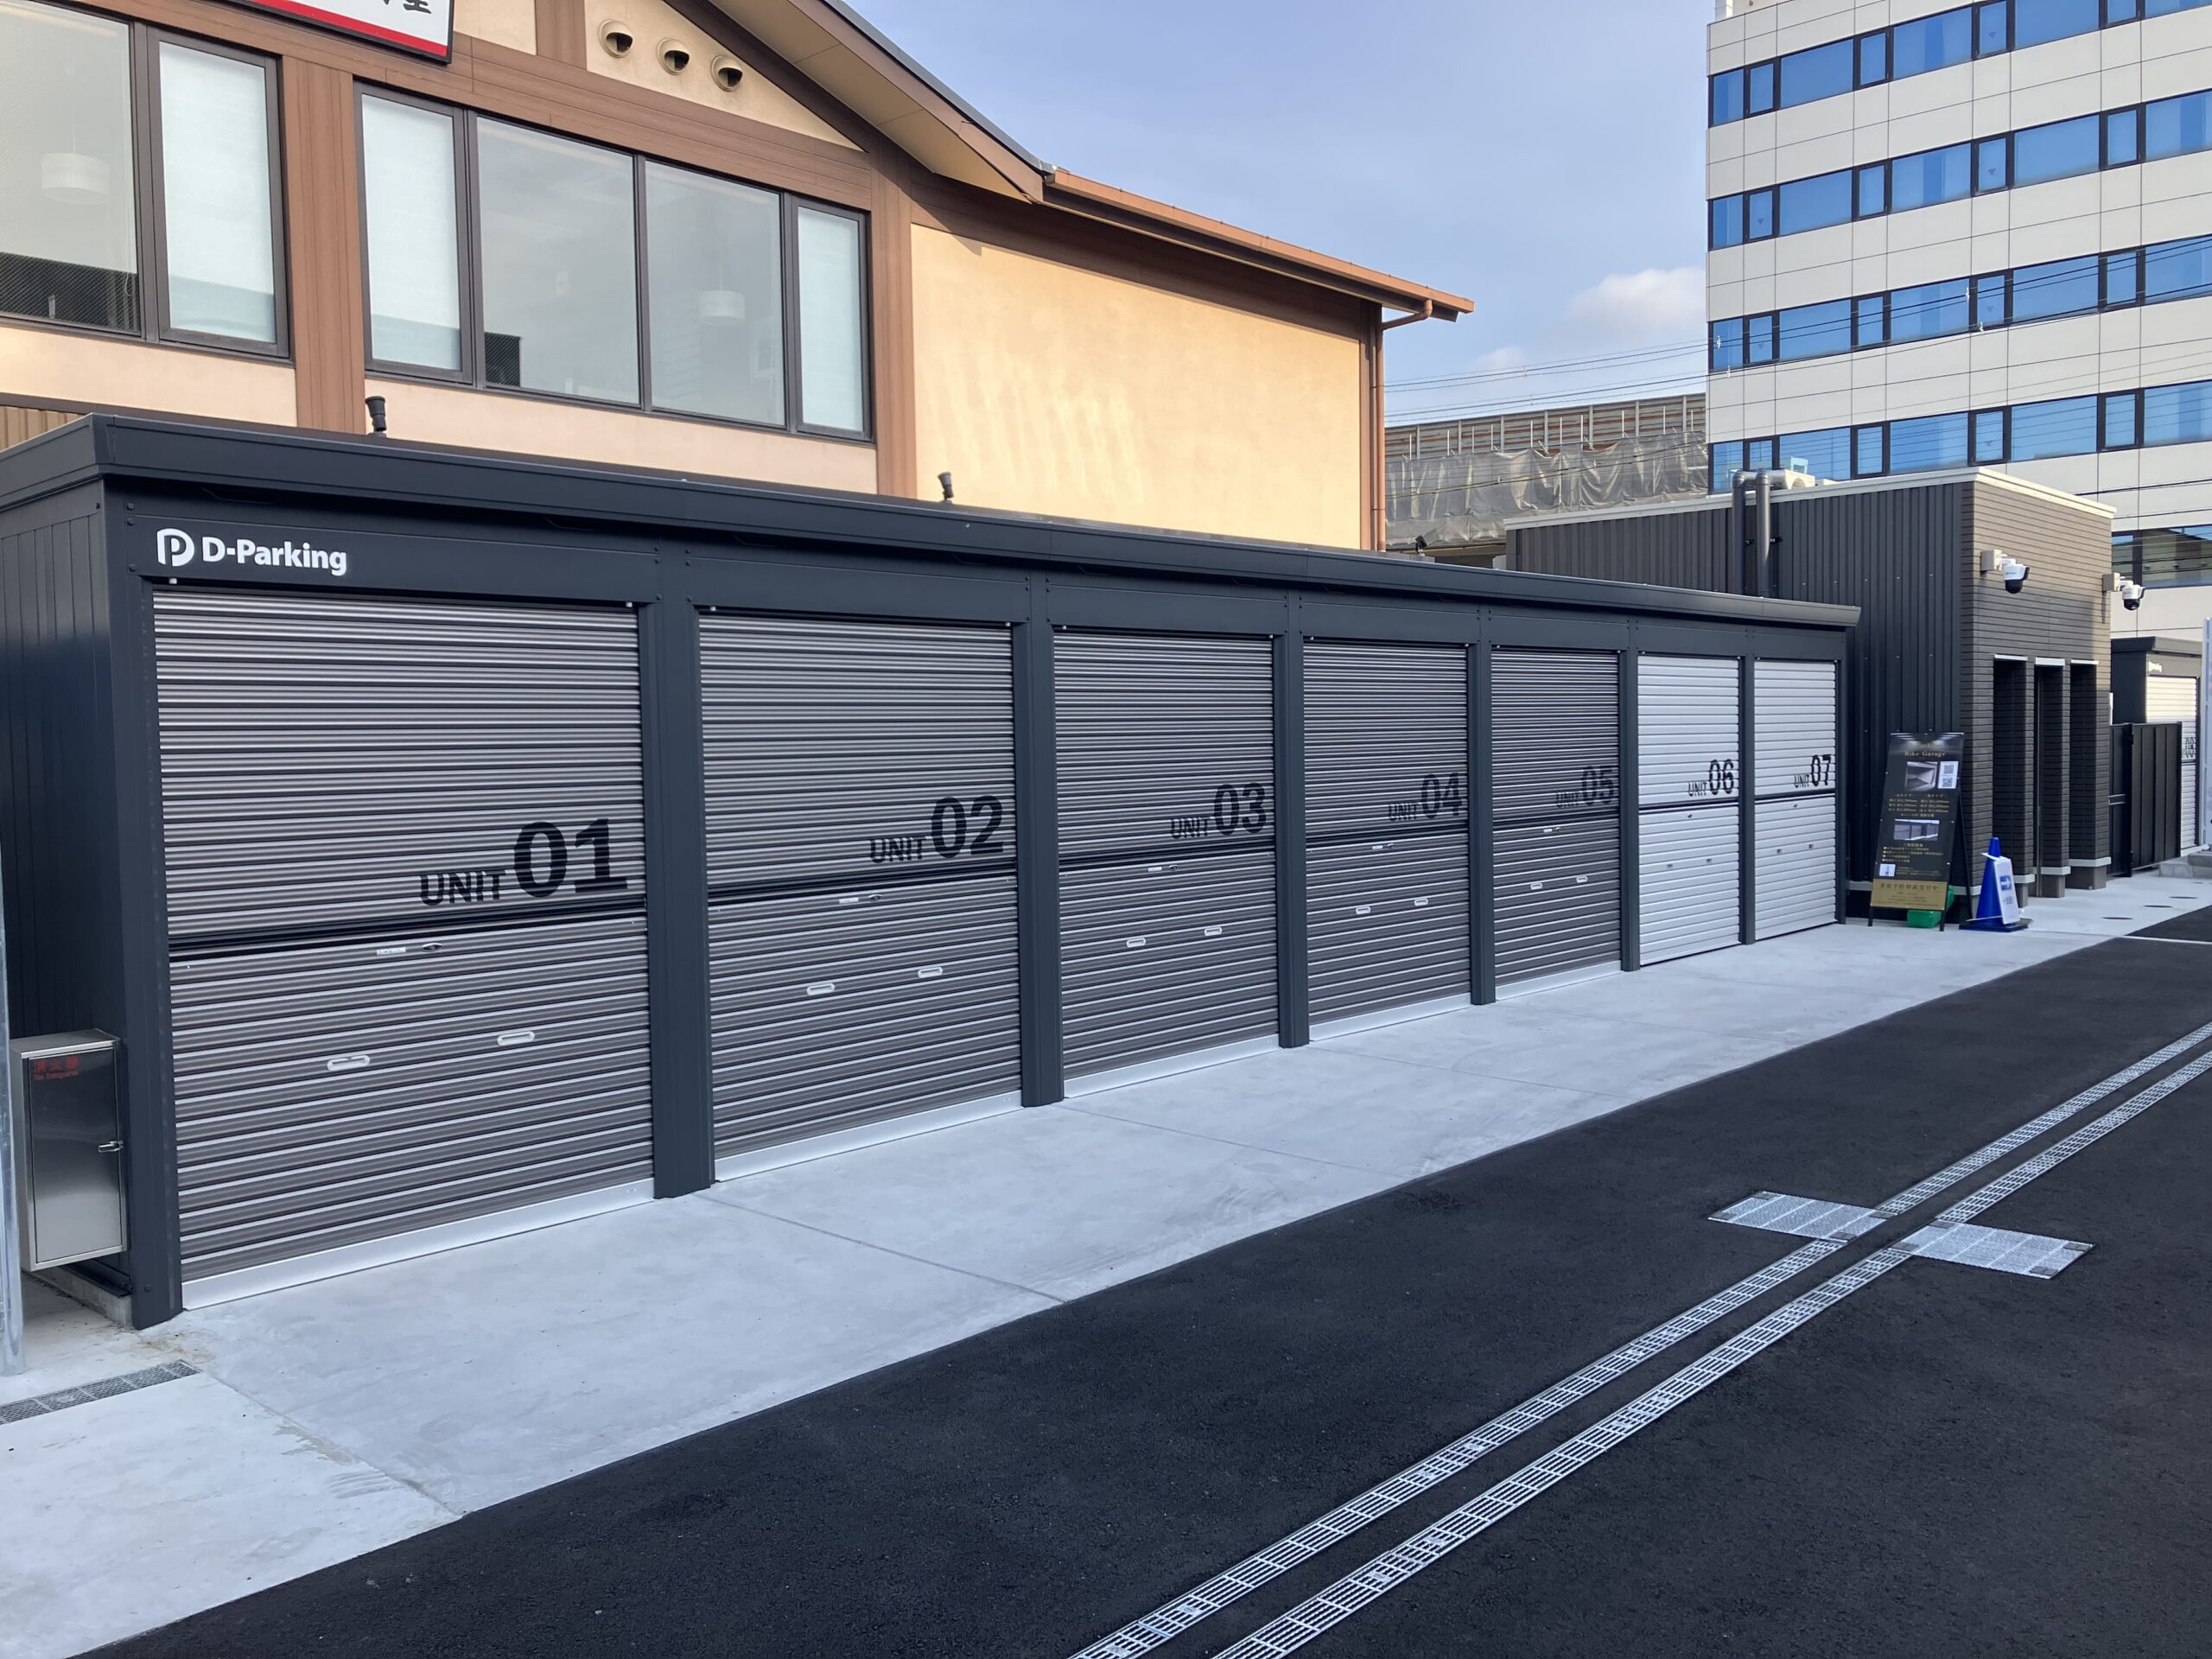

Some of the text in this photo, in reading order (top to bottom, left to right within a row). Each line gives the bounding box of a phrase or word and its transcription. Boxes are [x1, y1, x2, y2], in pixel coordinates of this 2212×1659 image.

[201, 536, 347, 576] D-Parking
[1582, 766, 1614, 805] 05
[1688, 759, 1734, 797] UNIT 06
[1811, 753, 1831, 787] 07
[1171, 782, 1267, 839] UNIT 03
[1389, 772, 1462, 822] UNIT 04
[869, 795, 1004, 863] UNIT 02
[418, 818, 628, 906] UNIT 01
